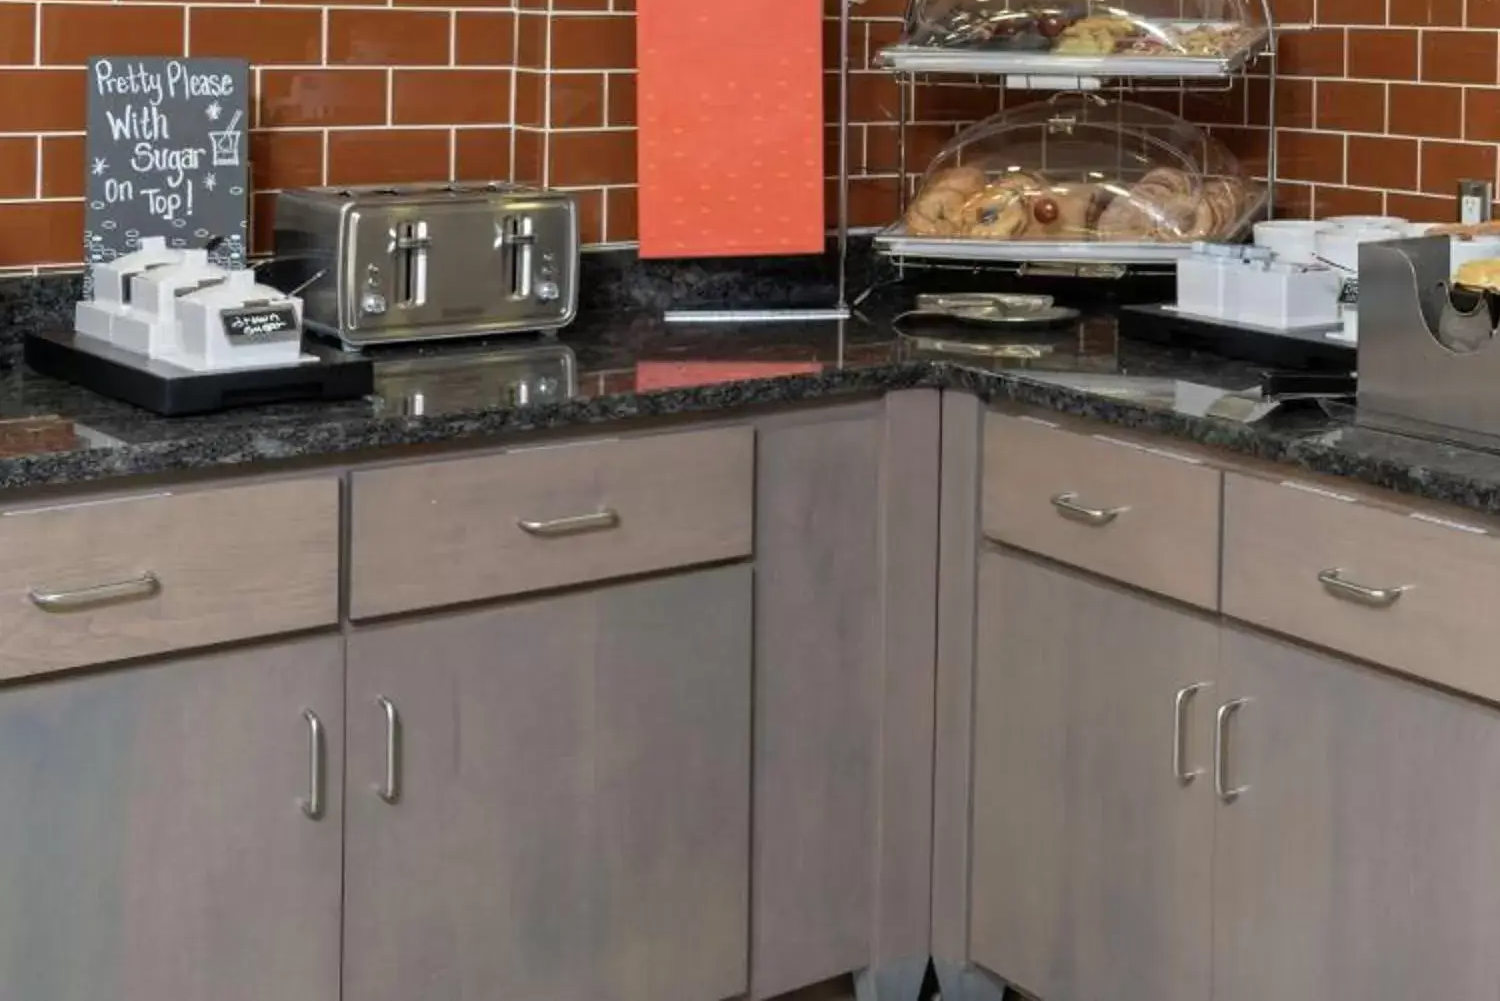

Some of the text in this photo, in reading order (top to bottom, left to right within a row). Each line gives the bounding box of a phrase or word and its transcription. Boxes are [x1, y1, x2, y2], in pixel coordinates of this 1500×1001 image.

[95, 59, 234, 106] Pretty Please
[105, 104, 170, 141] With
[131, 142, 206, 188] Sugar
